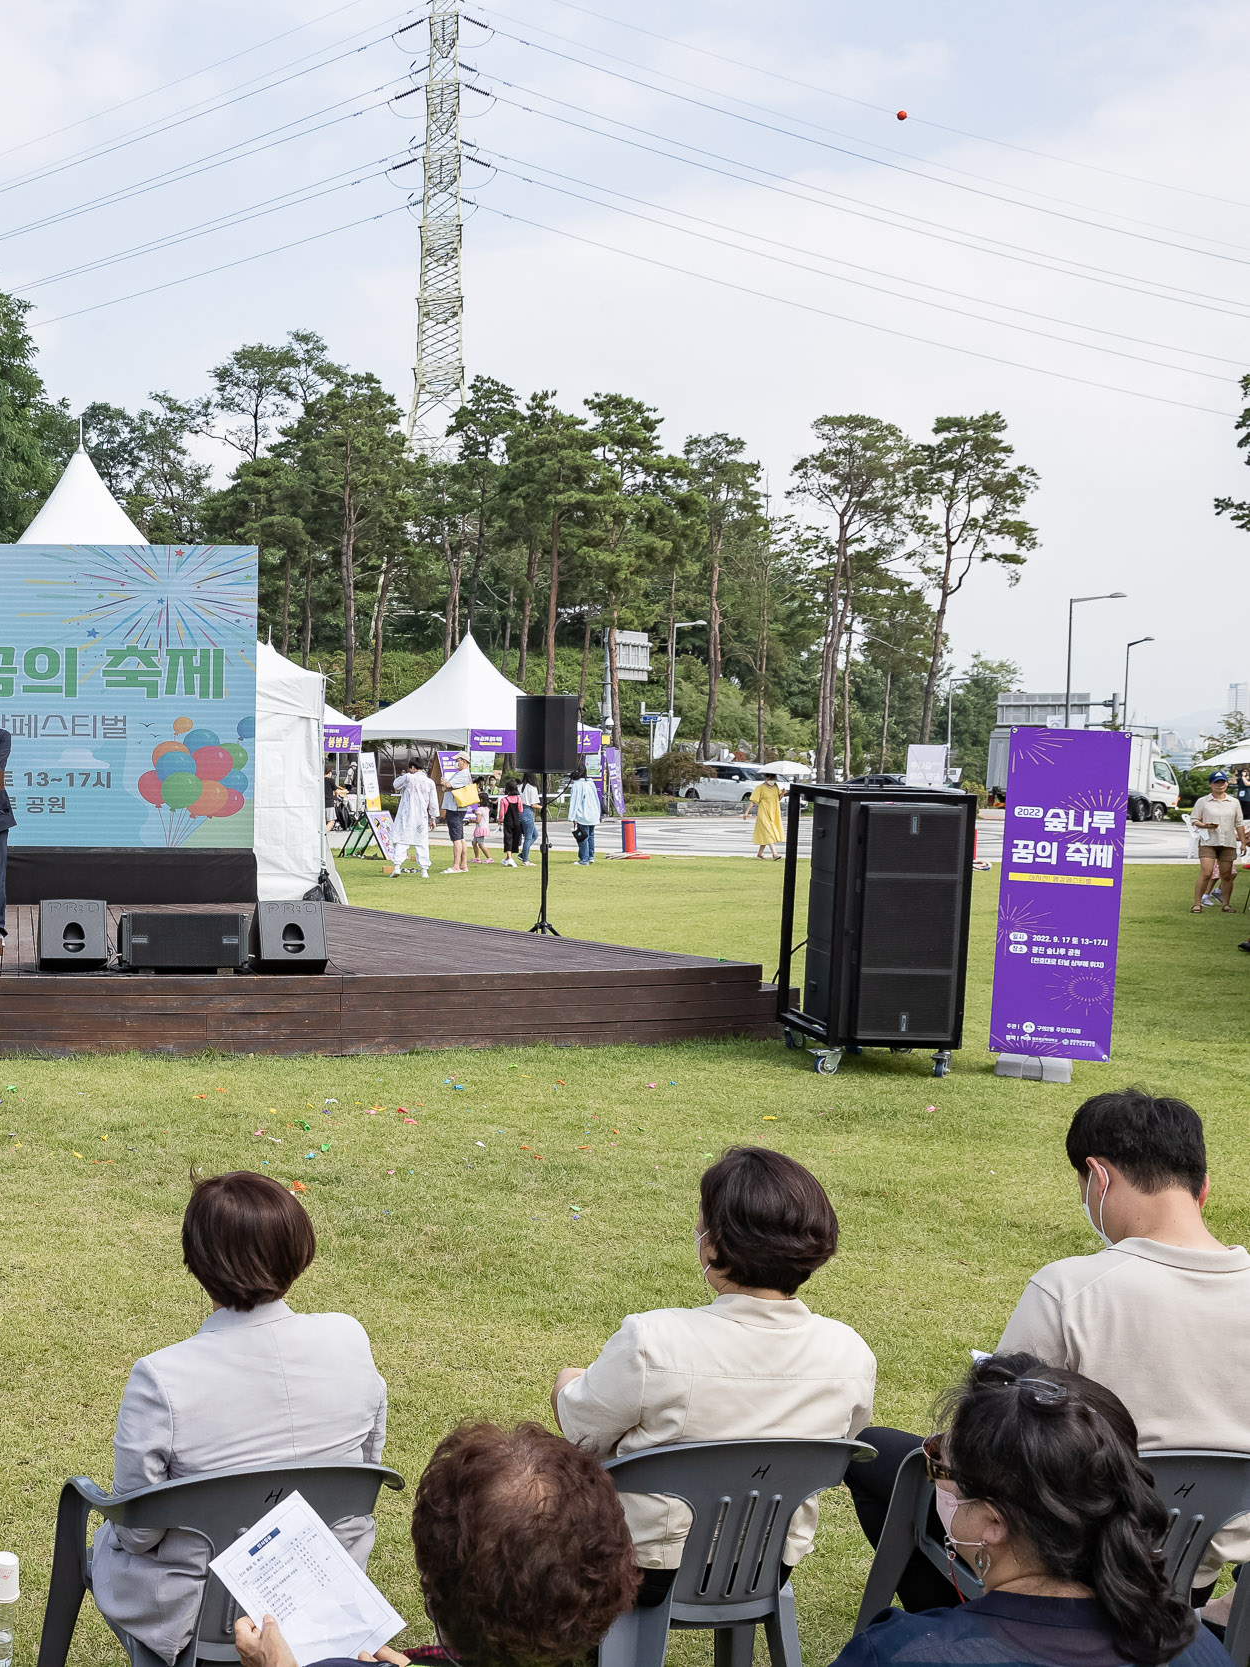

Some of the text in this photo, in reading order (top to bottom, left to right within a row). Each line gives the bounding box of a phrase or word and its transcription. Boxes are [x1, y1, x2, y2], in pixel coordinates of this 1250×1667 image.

[101, 646, 225, 699] 축제
[23, 771, 112, 788] 13~17시
[26, 797, 66, 814] 공원
[1017, 808, 1116, 835] 2022 숲나루
[1011, 840, 1113, 868] 꿈의 축제
[751, 1463, 772, 1480] H
[264, 1488, 283, 1504] H
[1173, 1482, 1196, 1499] H
